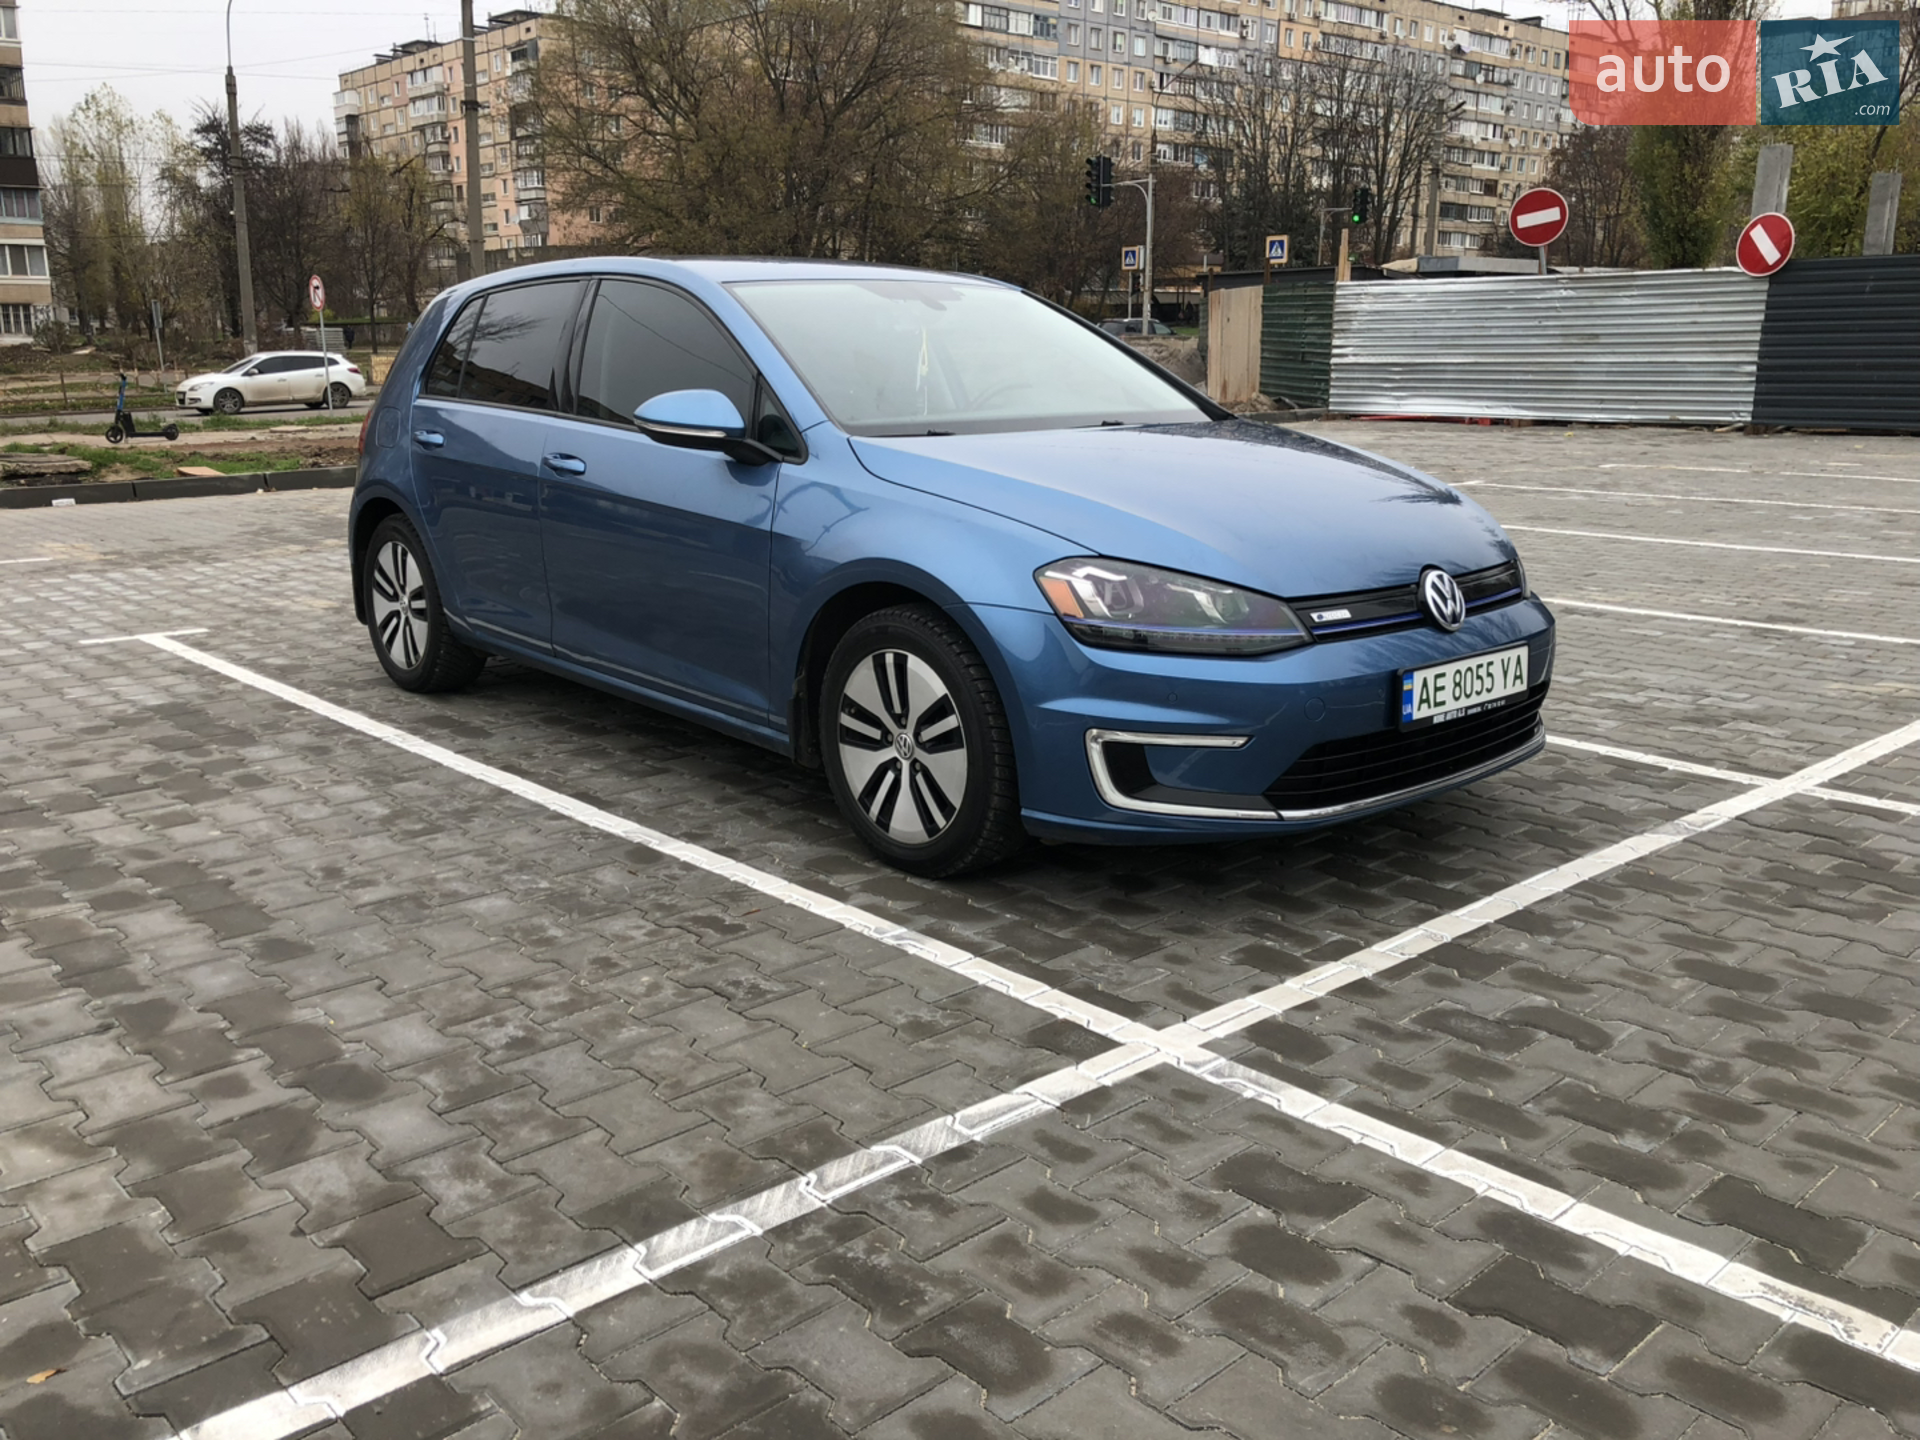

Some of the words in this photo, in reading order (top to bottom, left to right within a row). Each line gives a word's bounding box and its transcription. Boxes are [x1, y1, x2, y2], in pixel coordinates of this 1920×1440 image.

[1417, 671, 1447, 712] AE
[1452, 660, 1495, 702] 8055
[1501, 654, 1524, 690] YA
